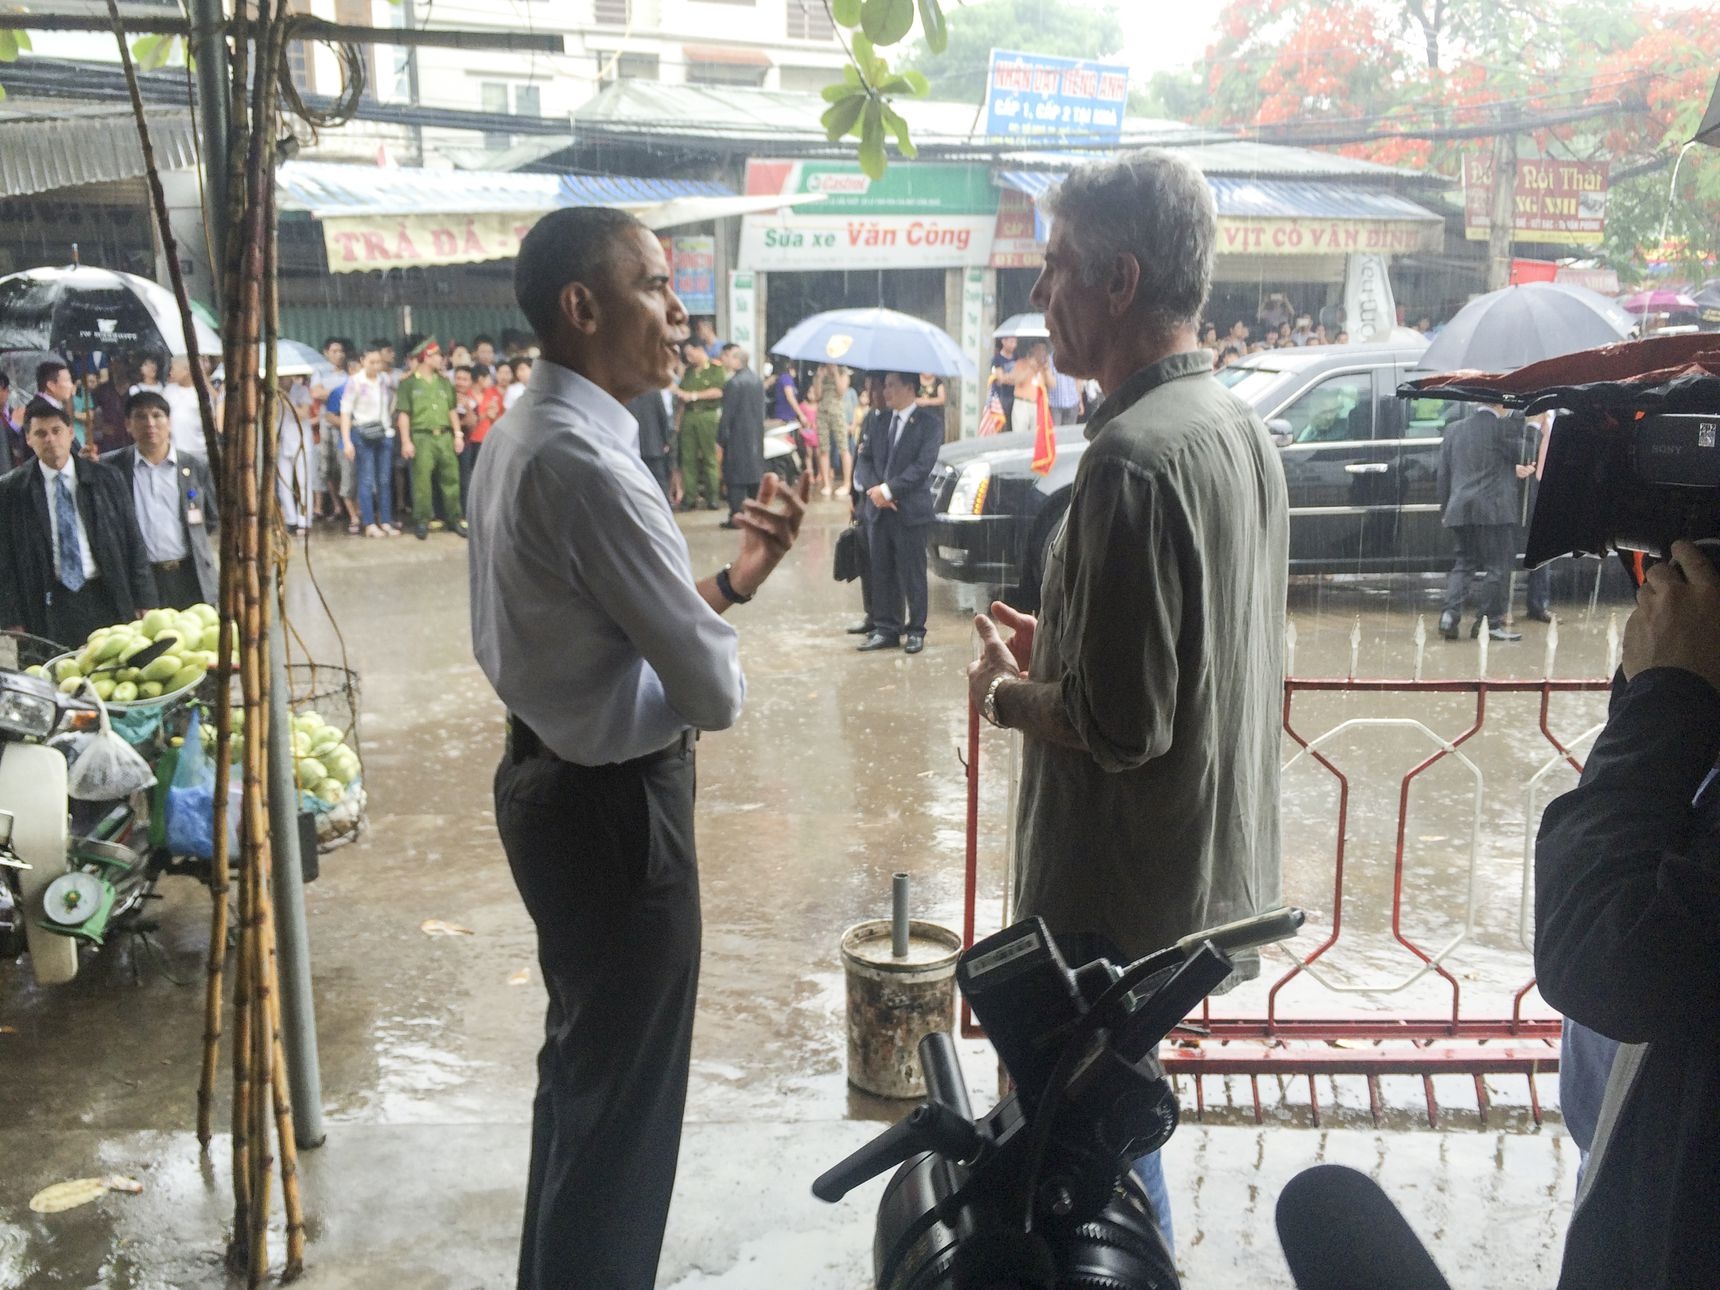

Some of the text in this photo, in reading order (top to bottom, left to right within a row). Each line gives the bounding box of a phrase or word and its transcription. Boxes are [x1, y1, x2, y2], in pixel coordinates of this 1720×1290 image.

[812, 232, 836, 248] xe
[847, 220, 897, 247] Văn
[905, 221, 972, 251] Công
[1224, 226, 1266, 252] VỊT
